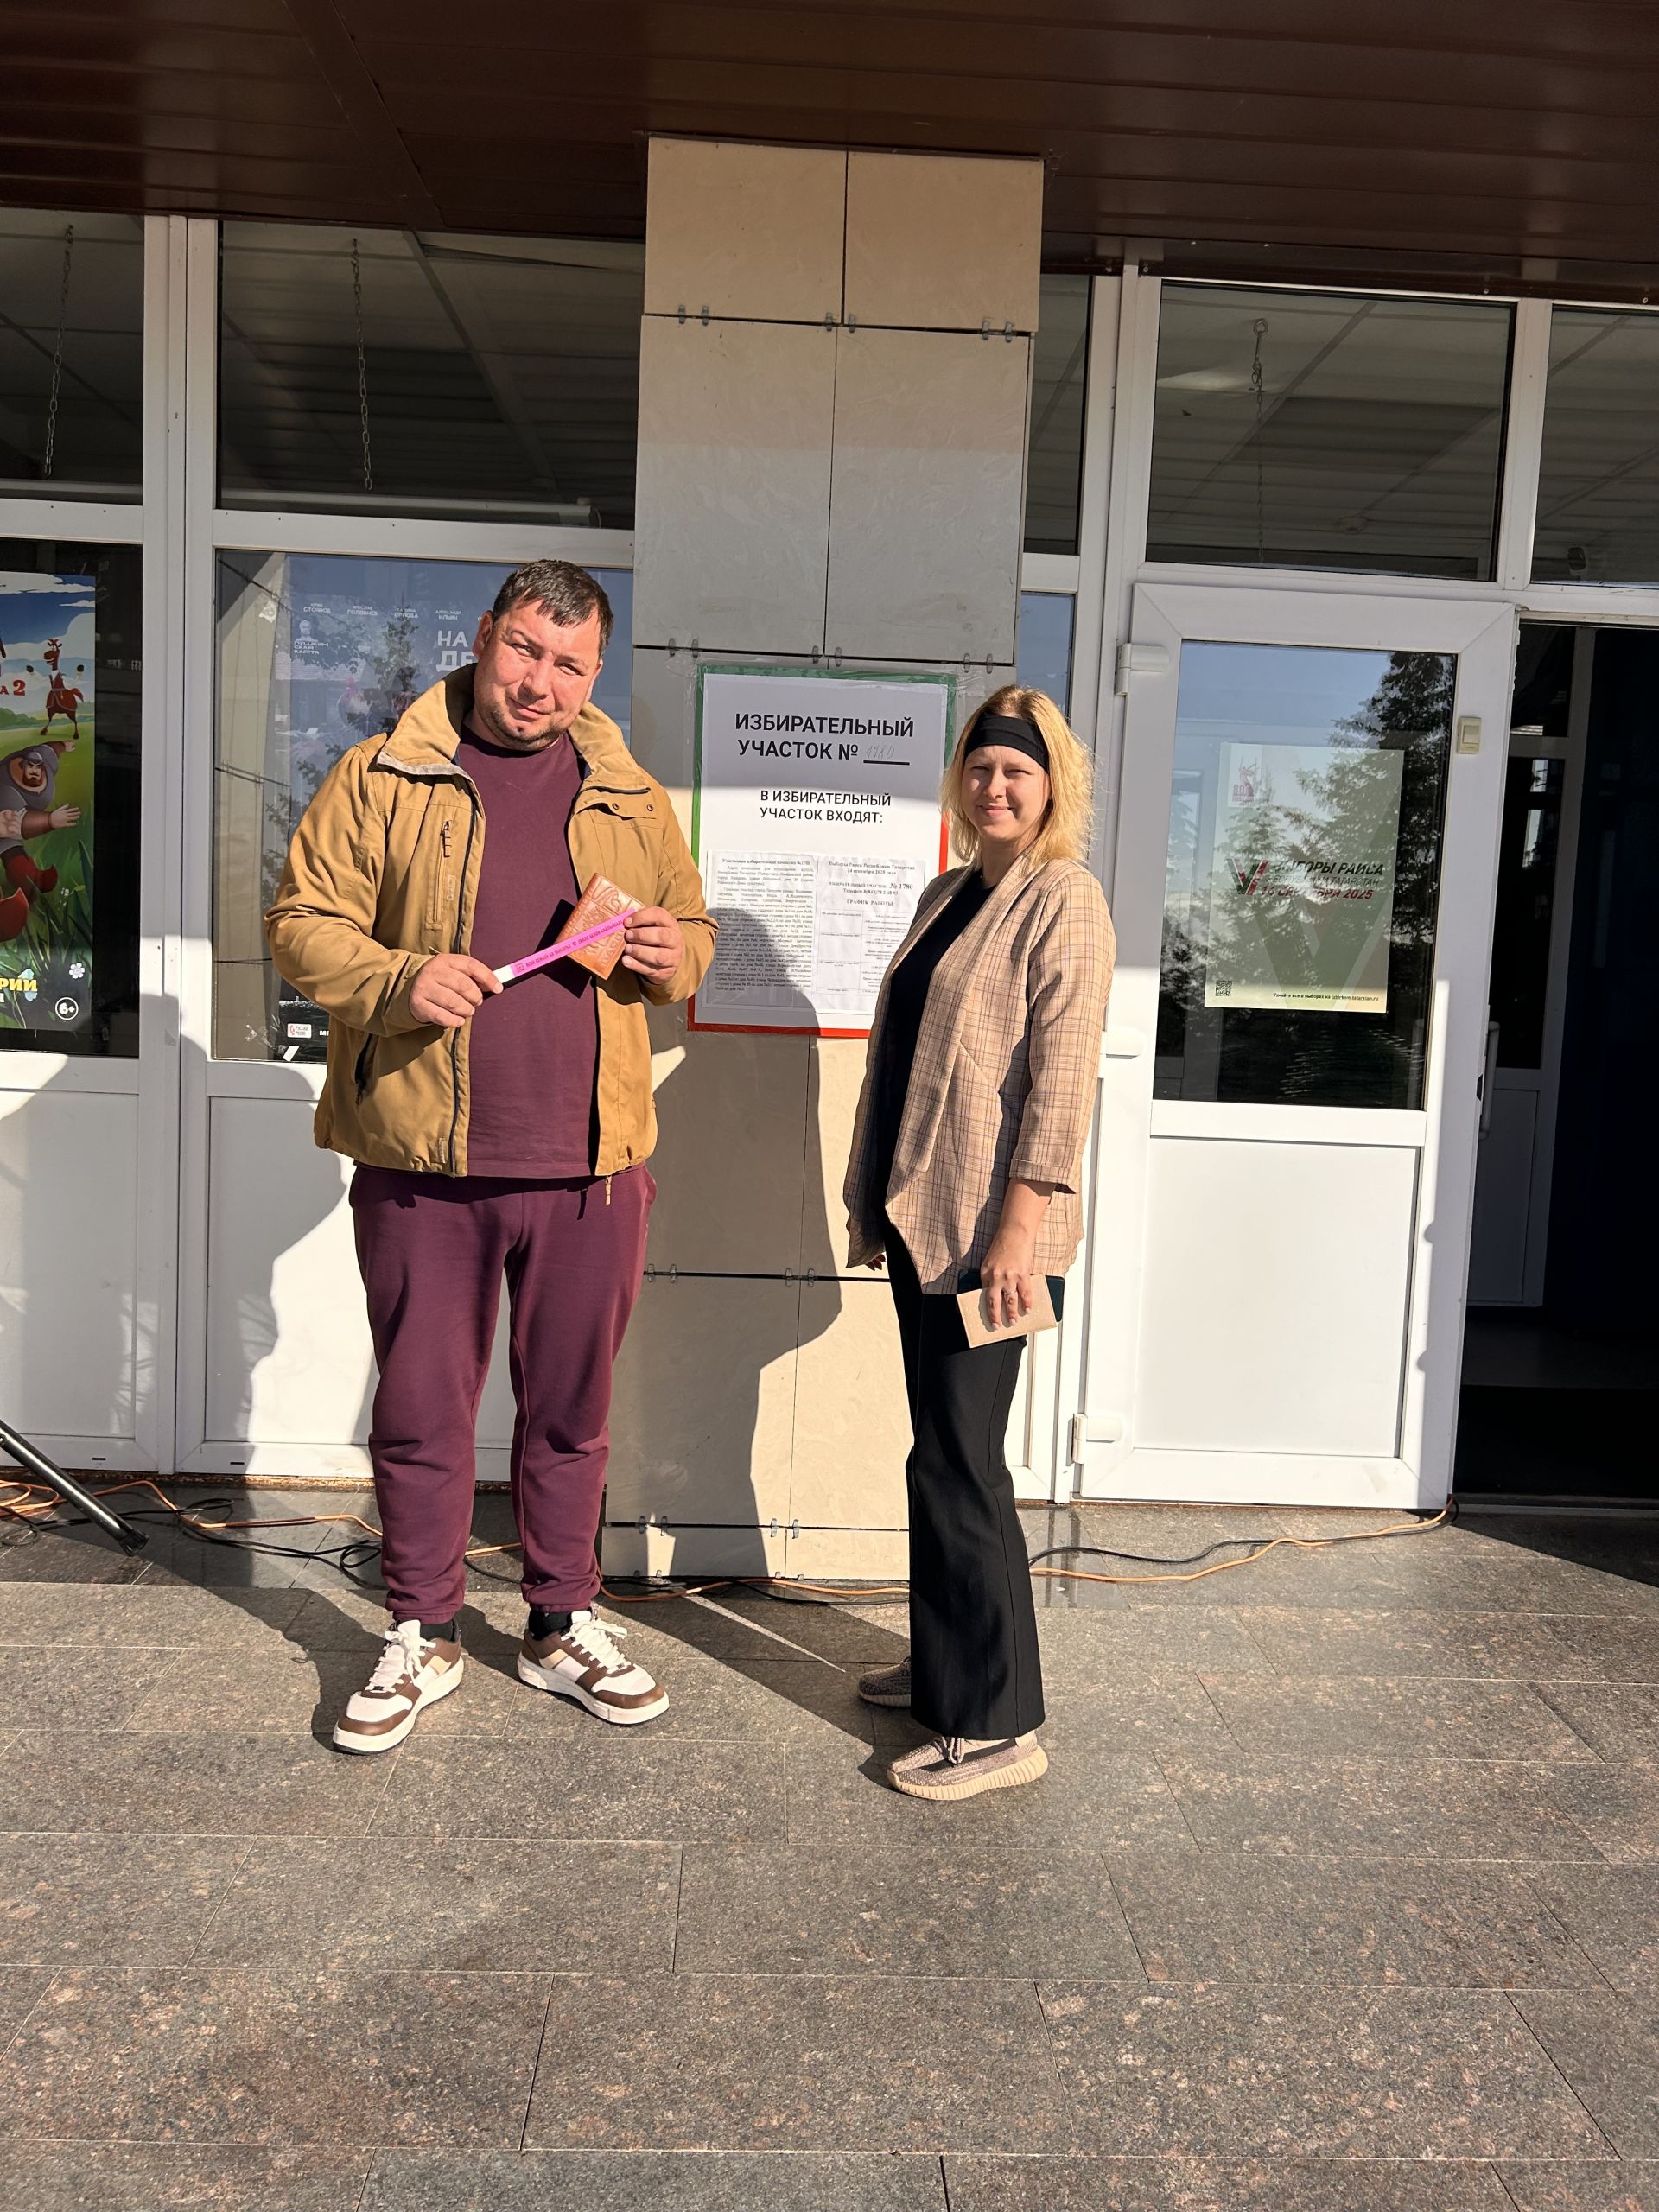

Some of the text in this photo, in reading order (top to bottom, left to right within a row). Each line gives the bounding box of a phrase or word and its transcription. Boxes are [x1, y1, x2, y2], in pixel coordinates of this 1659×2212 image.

[437, 630, 468, 648] НА
[13, 680, 26, 696] 2
[735, 713, 914, 737] ИЗБИРАТЕЛЬНЫЙ
[738, 739, 895, 760] УЧАСТОК № 1780
[760, 790, 891, 806] В ИЗБИРАТЕЛЬНЫЙ
[760, 807, 883, 824] УЧАСТОК ВХОДЯТ:
[1271, 860, 1384, 875] БОРЫ РАИСА
[1331, 876, 1380, 887] ТАТАРСТАН
[1277, 885, 1341, 898] СЕБРЯ
[1342, 889, 1376, 899] 2025
[59, 1002, 75, 1015] 6+
